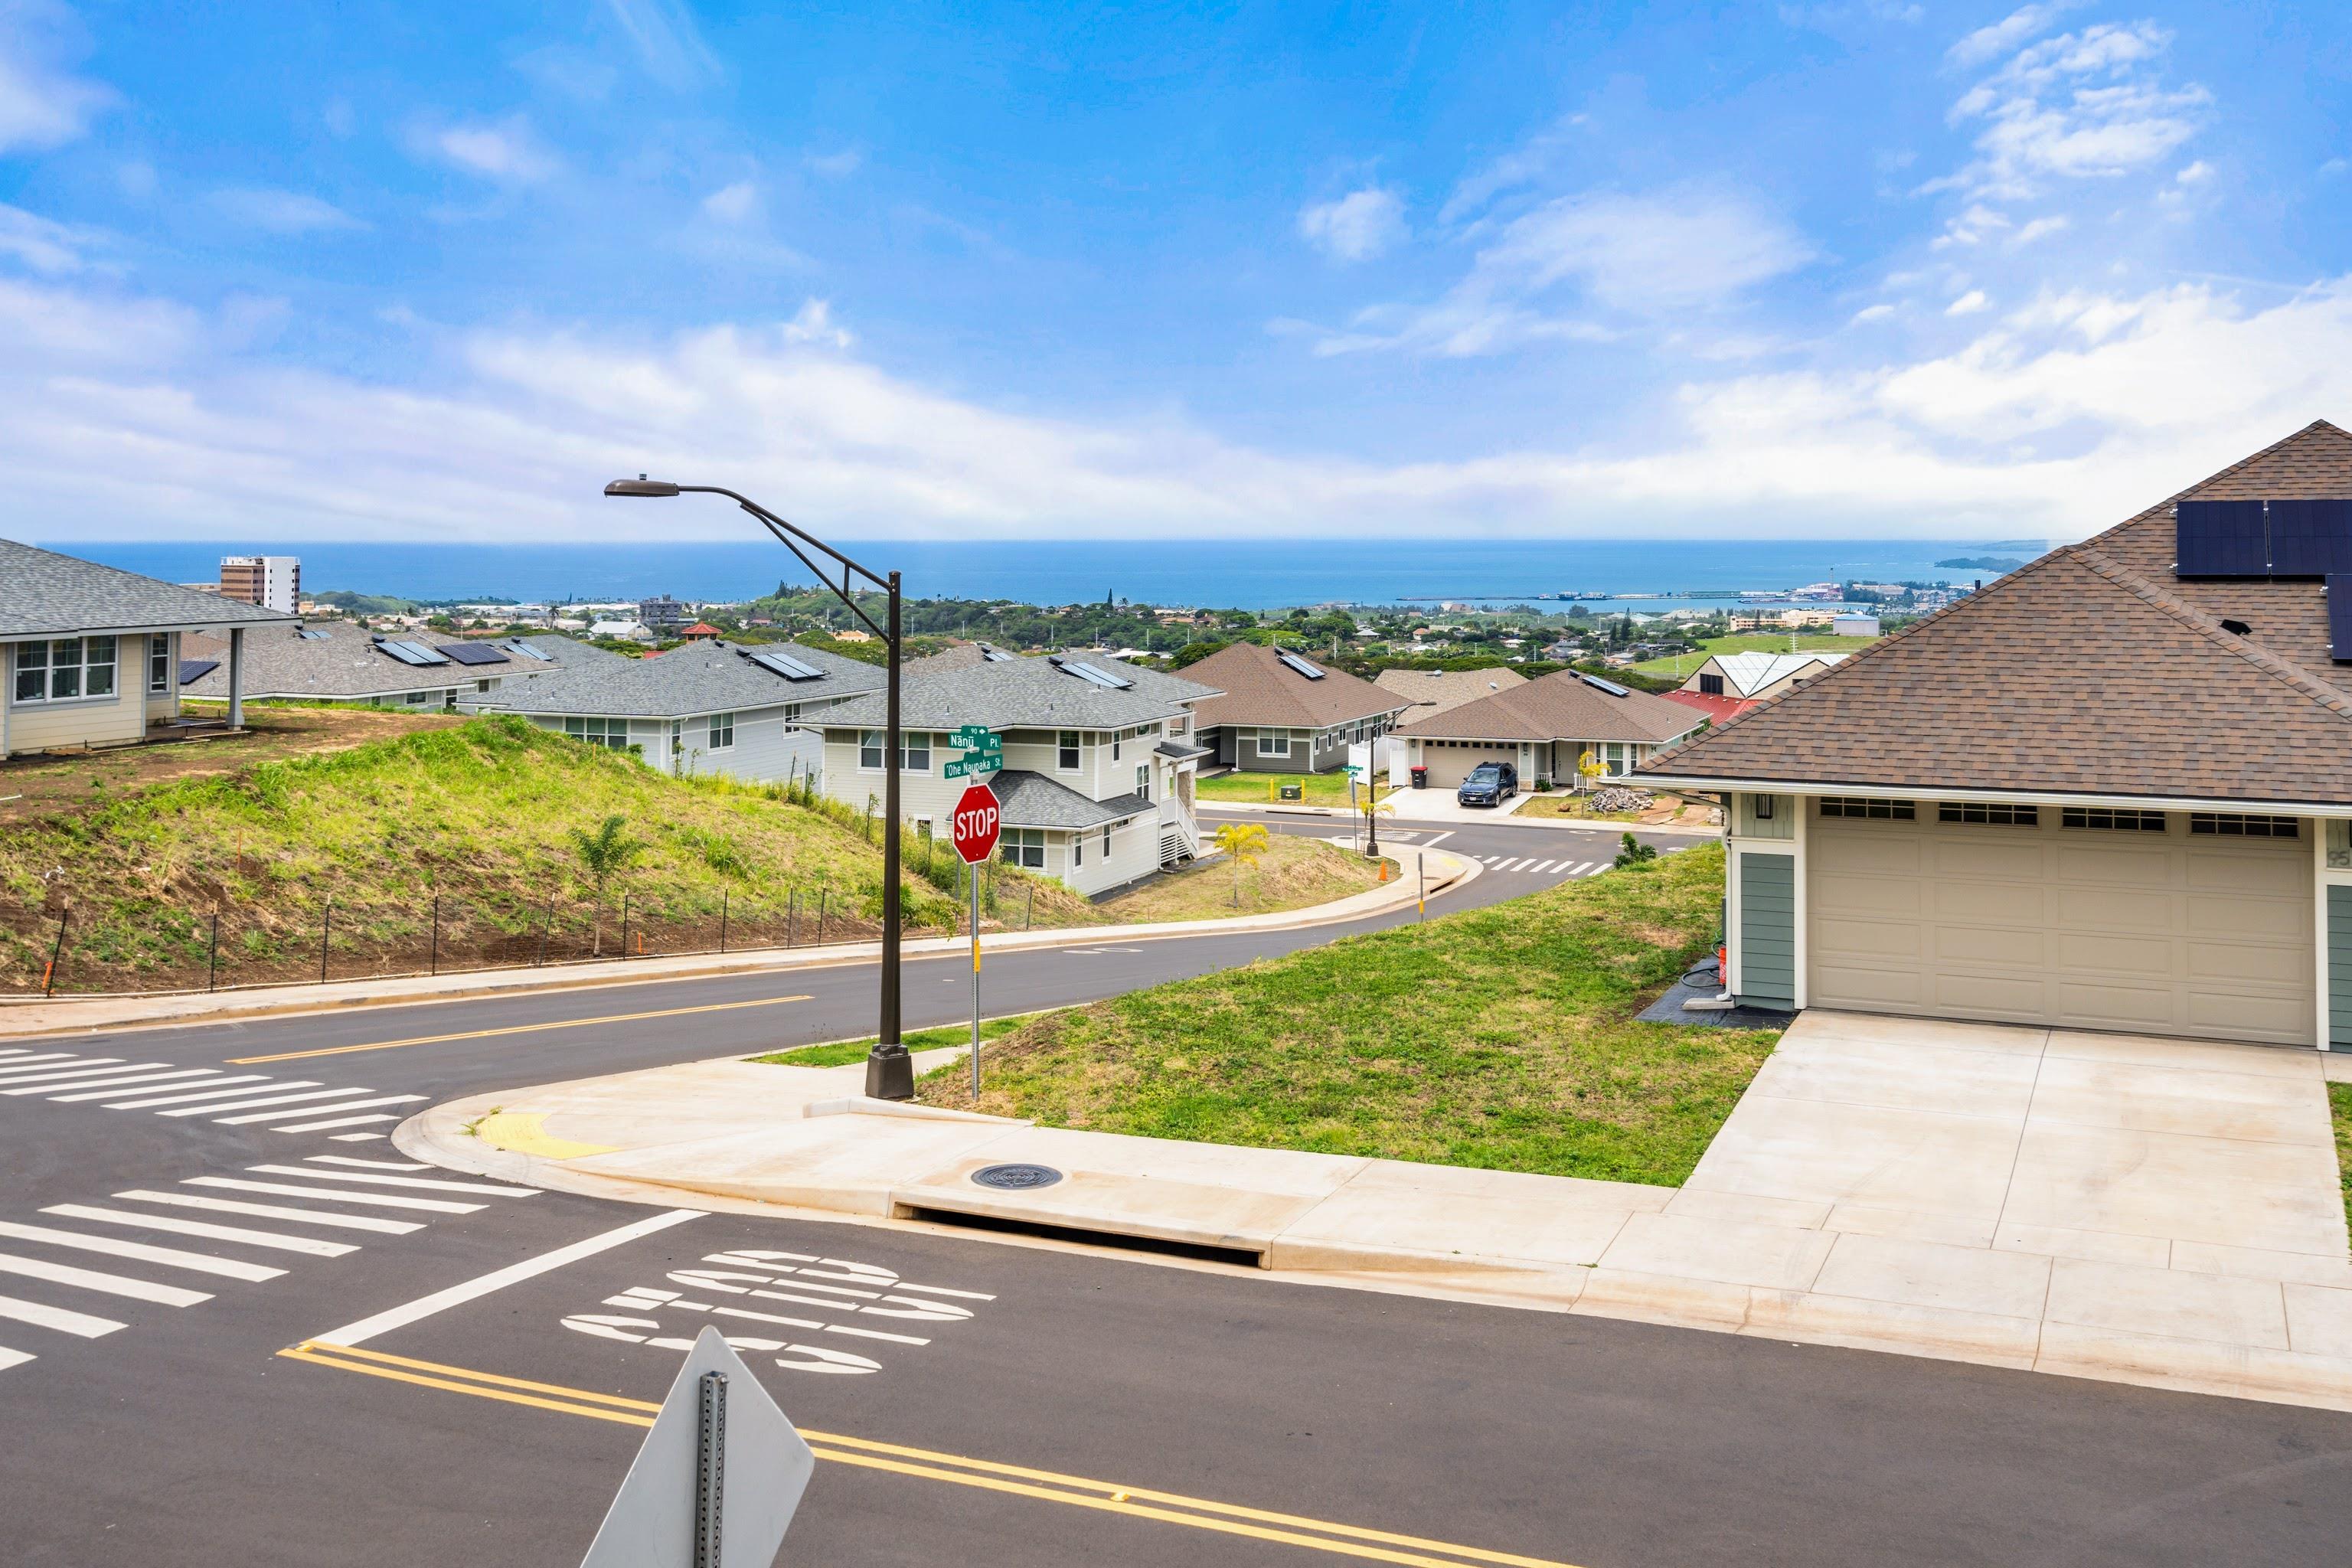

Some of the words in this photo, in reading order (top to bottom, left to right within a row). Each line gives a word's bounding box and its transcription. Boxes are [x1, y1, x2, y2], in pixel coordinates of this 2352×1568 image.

[990, 738, 999, 747] Pl.
[963, 760, 991, 775] Naupaka
[956, 807, 997, 841] STOP
[560, 1250, 997, 1374] STOP
